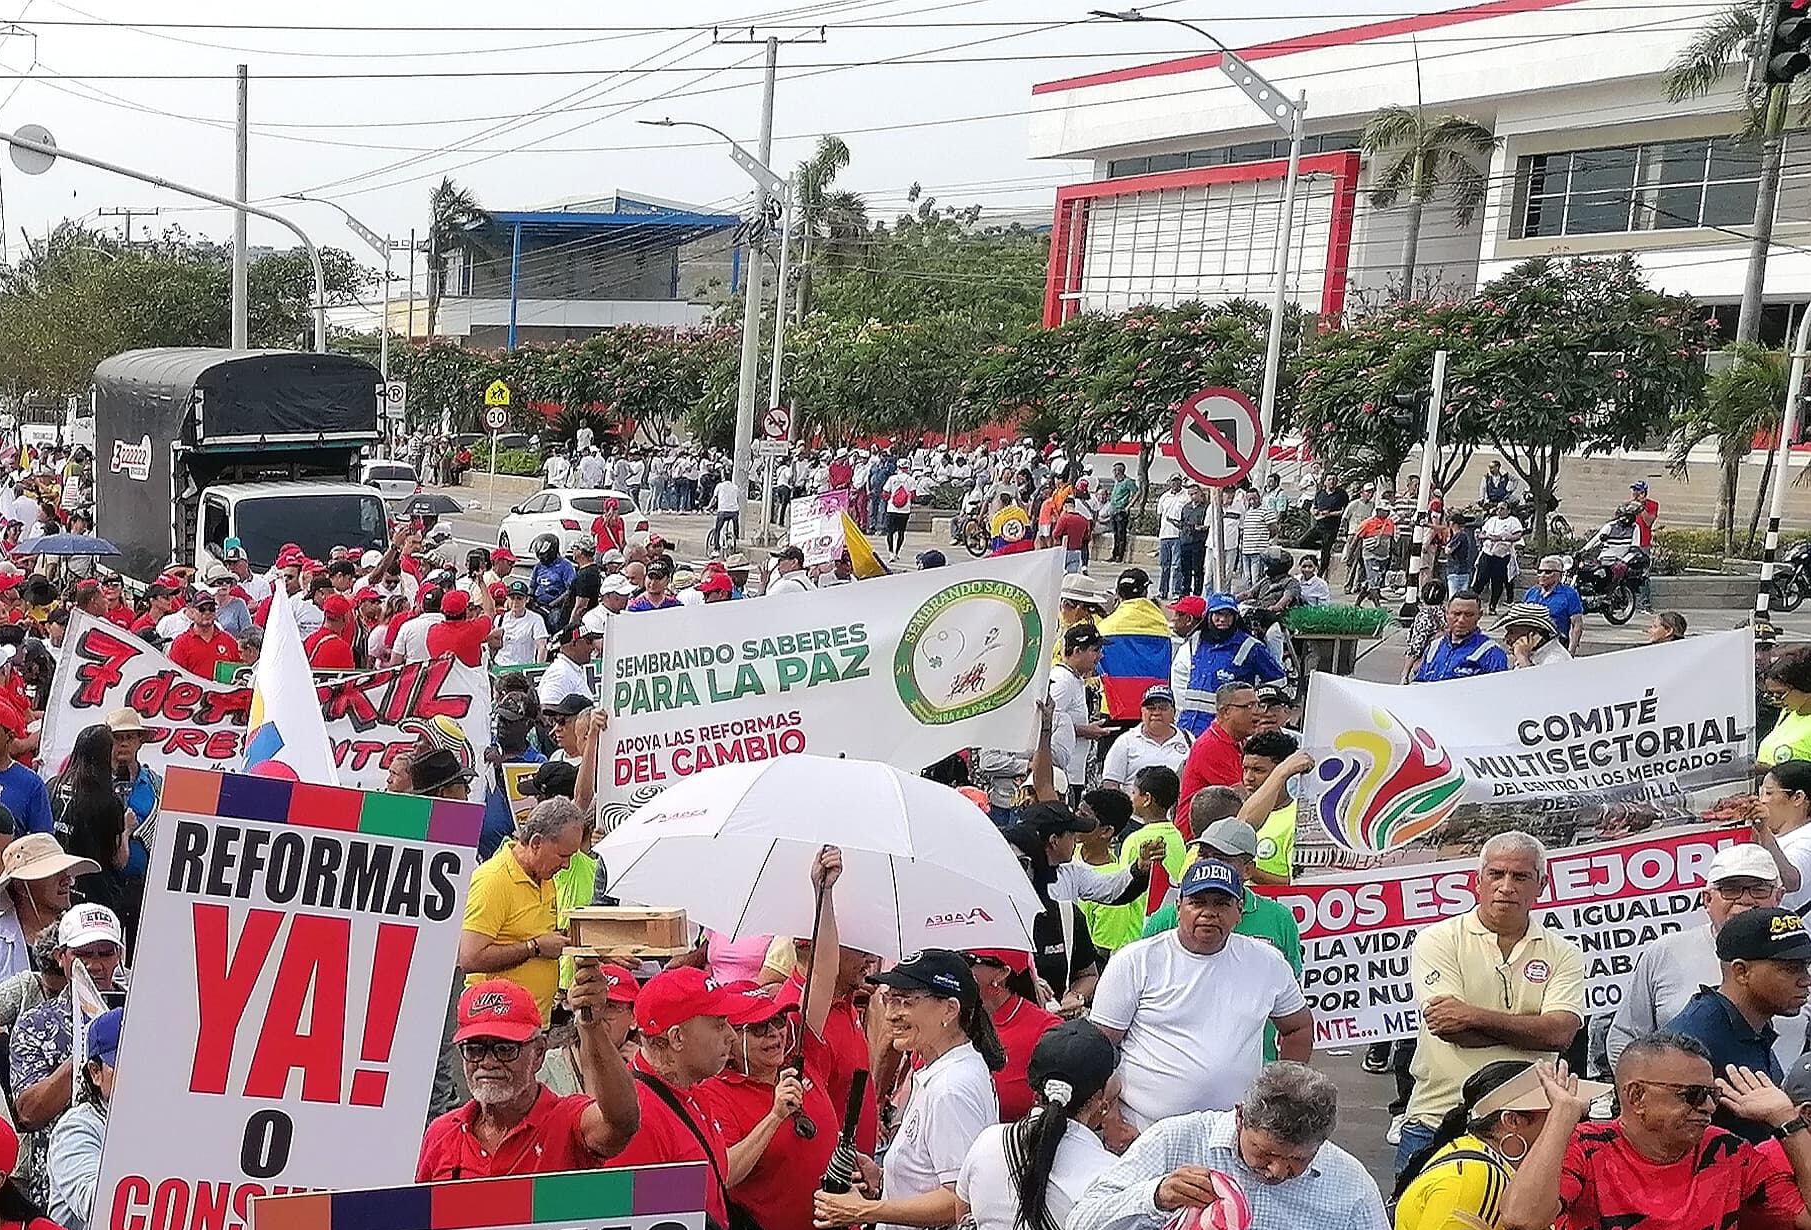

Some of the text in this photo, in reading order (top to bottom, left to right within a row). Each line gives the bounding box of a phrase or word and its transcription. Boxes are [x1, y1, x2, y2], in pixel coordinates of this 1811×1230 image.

[490, 411, 505, 423] 30
[904, 580, 983, 644] SEMBRANDO
[73, 628, 142, 707] 7
[614, 672, 700, 718] PARA
[706, 662, 766, 704] LA
[776, 643, 871, 692] PAZ
[615, 622, 869, 680] SEMBRANDO SABERES
[614, 728, 807, 787] DEL CAMBIO
[615, 710, 803, 756] APOYA LAS REFORMAS
[1464, 715, 1748, 780] MULTISECTORIAL
[1492, 749, 1733, 798] DEL CENTRO Y LOS MERCADOS
[1541, 796, 1569, 812] DE
[166, 820, 462, 922] REFORMAS
[1399, 873, 1478, 920] ES
[1536, 838, 1734, 905] EJOR
[1303, 965, 1361, 990] POR
[1313, 938, 1347, 962] LA
[188, 902, 419, 1108] YA!
[1306, 991, 1361, 1012] POR
[239, 1109, 295, 1179] O
